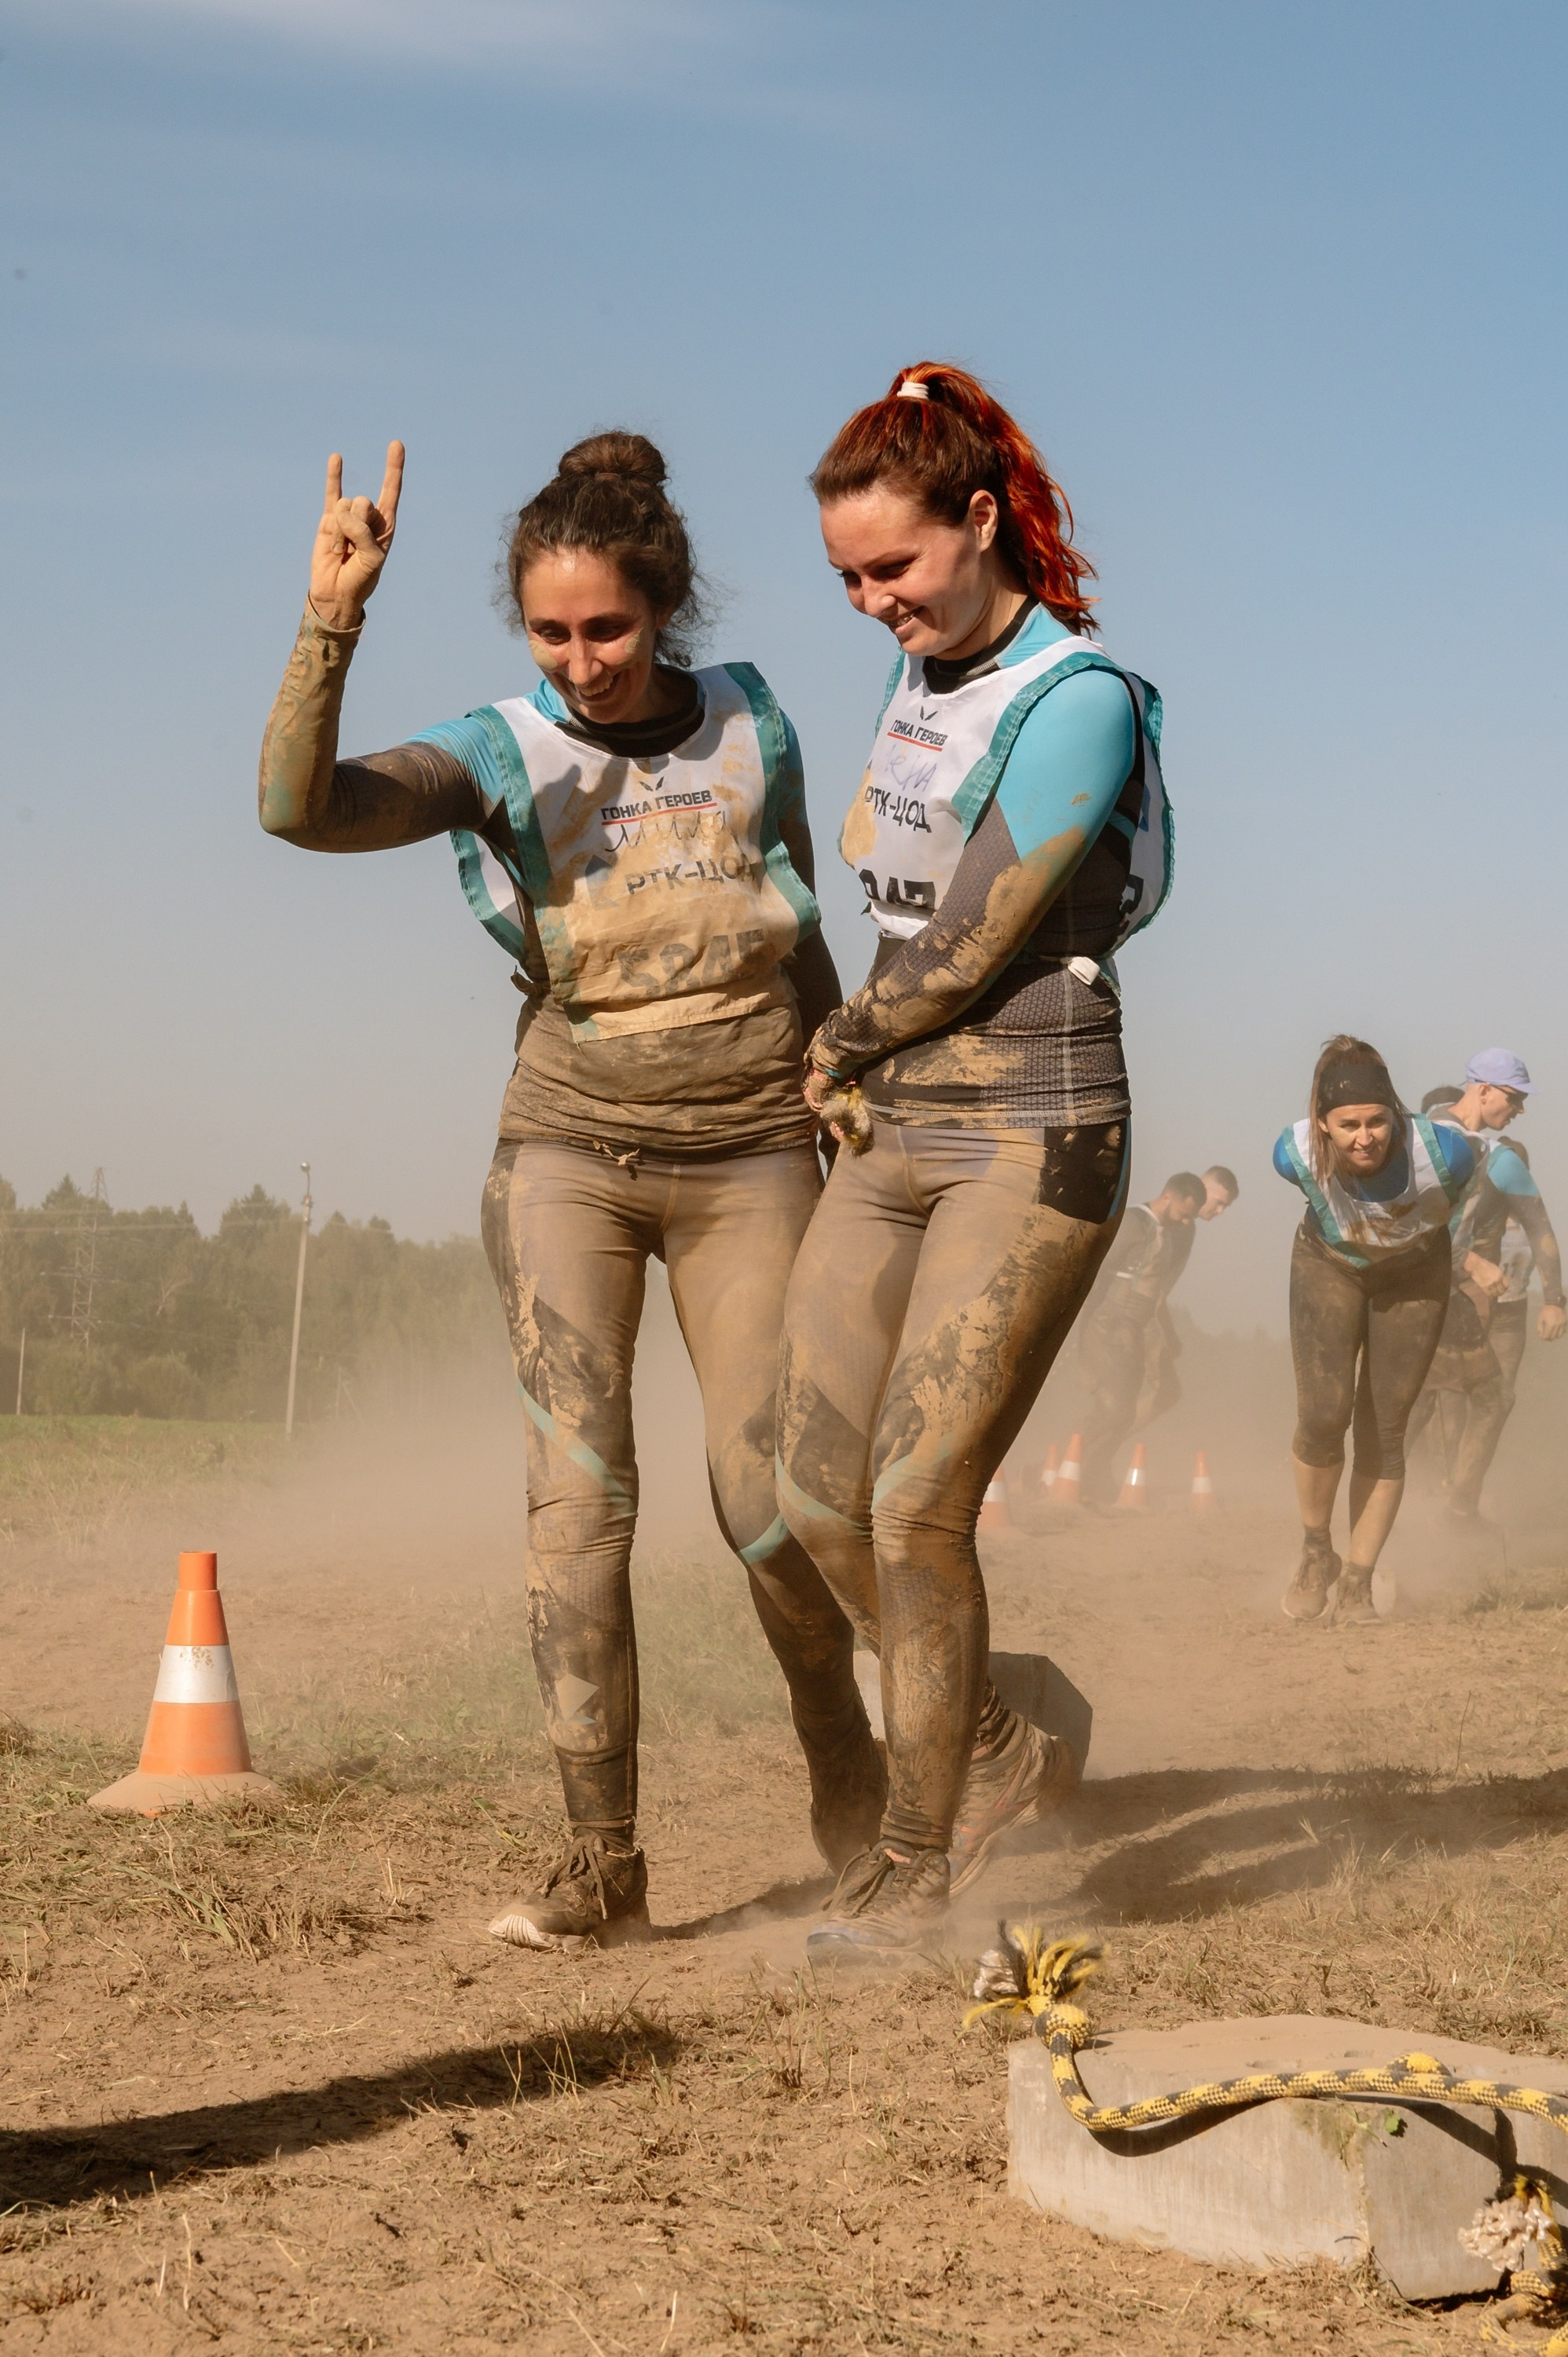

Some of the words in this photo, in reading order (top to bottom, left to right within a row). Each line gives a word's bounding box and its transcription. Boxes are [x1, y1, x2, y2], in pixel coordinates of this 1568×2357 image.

[890, 719, 914, 738] ГОНКА
[914, 726, 948, 746] ГЕРОЕВ
[600, 800, 652, 820] ГОНКА
[654, 790, 713, 810] ГЕРОЕВ
[864, 786, 932, 834] РТК-ЦОД
